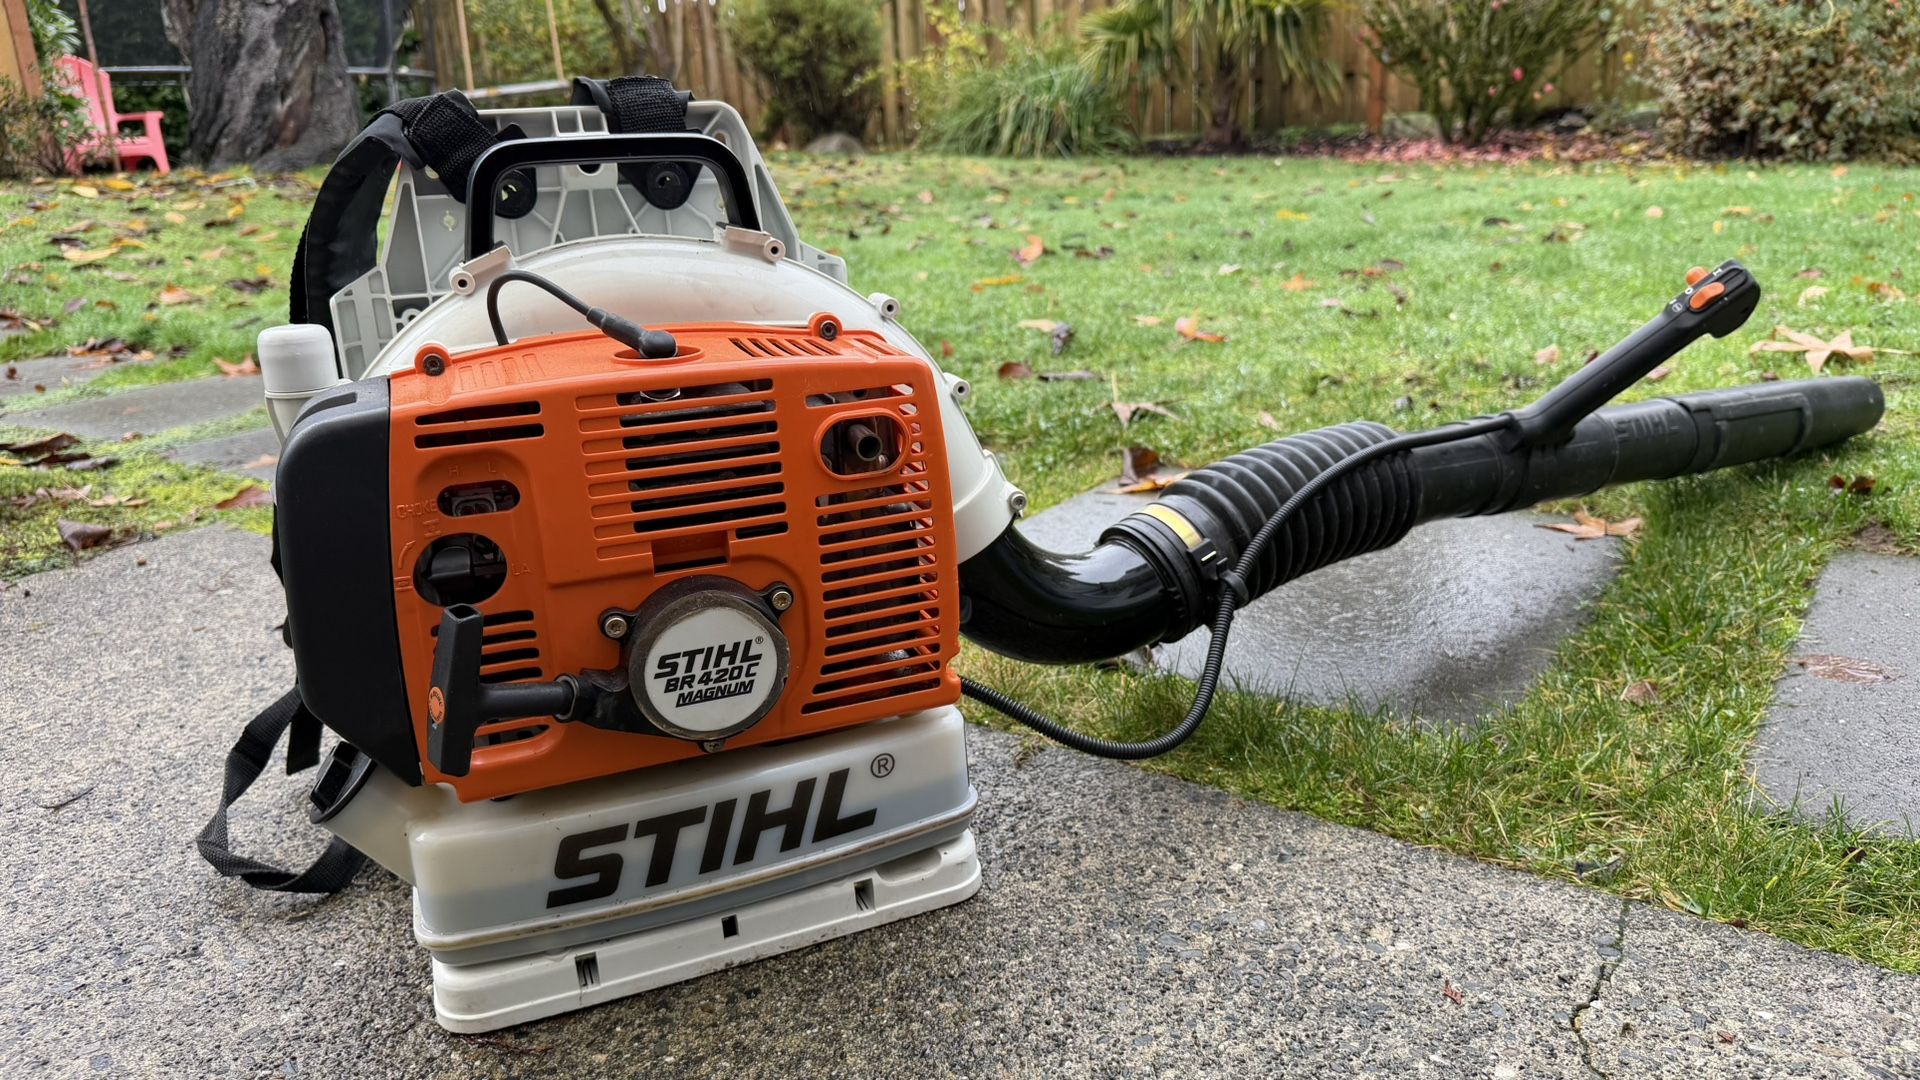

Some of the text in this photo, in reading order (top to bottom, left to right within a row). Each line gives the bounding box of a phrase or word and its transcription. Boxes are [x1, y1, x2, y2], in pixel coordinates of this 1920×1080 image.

[1615, 409, 1680, 441] STIHL
[396, 499, 438, 519] CHOKE
[663, 674, 696, 694] BR
[675, 679, 755, 708] MAGNUM
